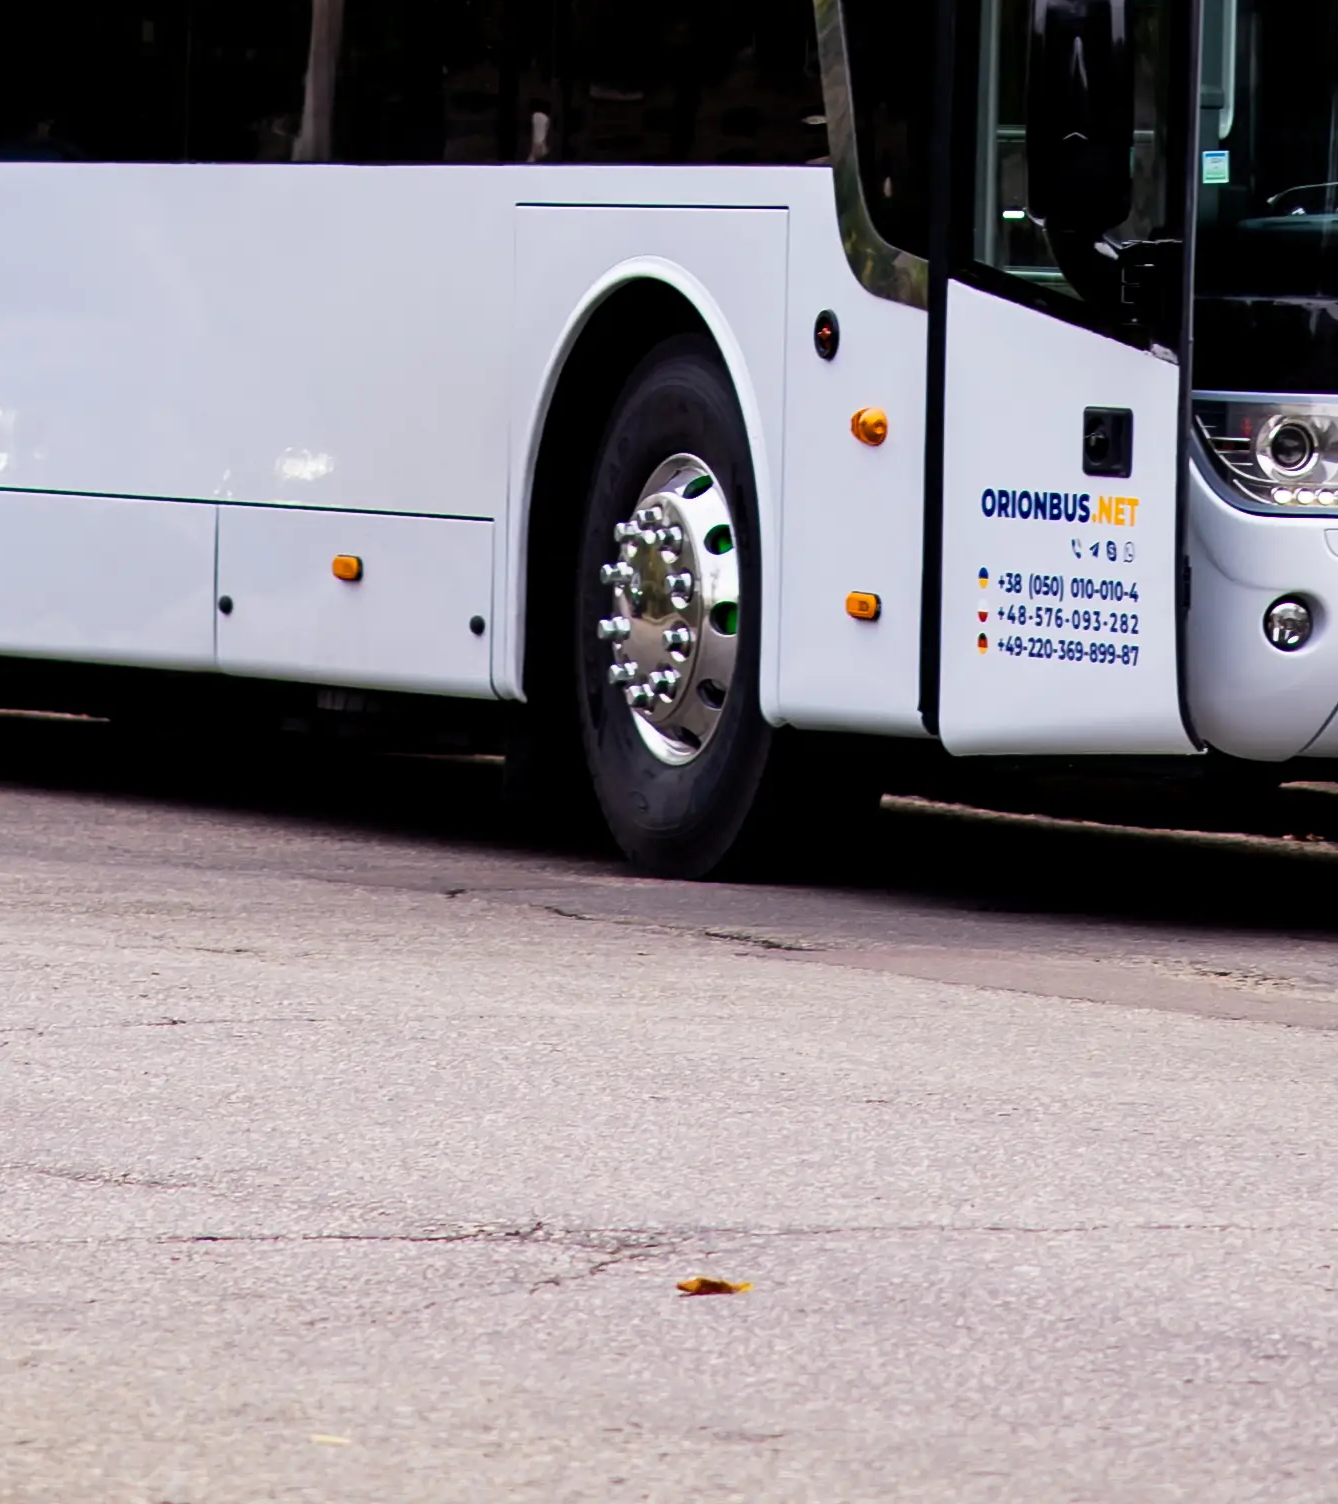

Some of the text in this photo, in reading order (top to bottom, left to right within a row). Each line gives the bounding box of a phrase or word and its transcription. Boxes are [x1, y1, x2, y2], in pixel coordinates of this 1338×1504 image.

[981, 488, 1139, 526] ORIONBUS.NET
[998, 573, 1139, 602] +38 (050) 010-010-4
[997, 604, 1139, 635] +48-576-093-282
